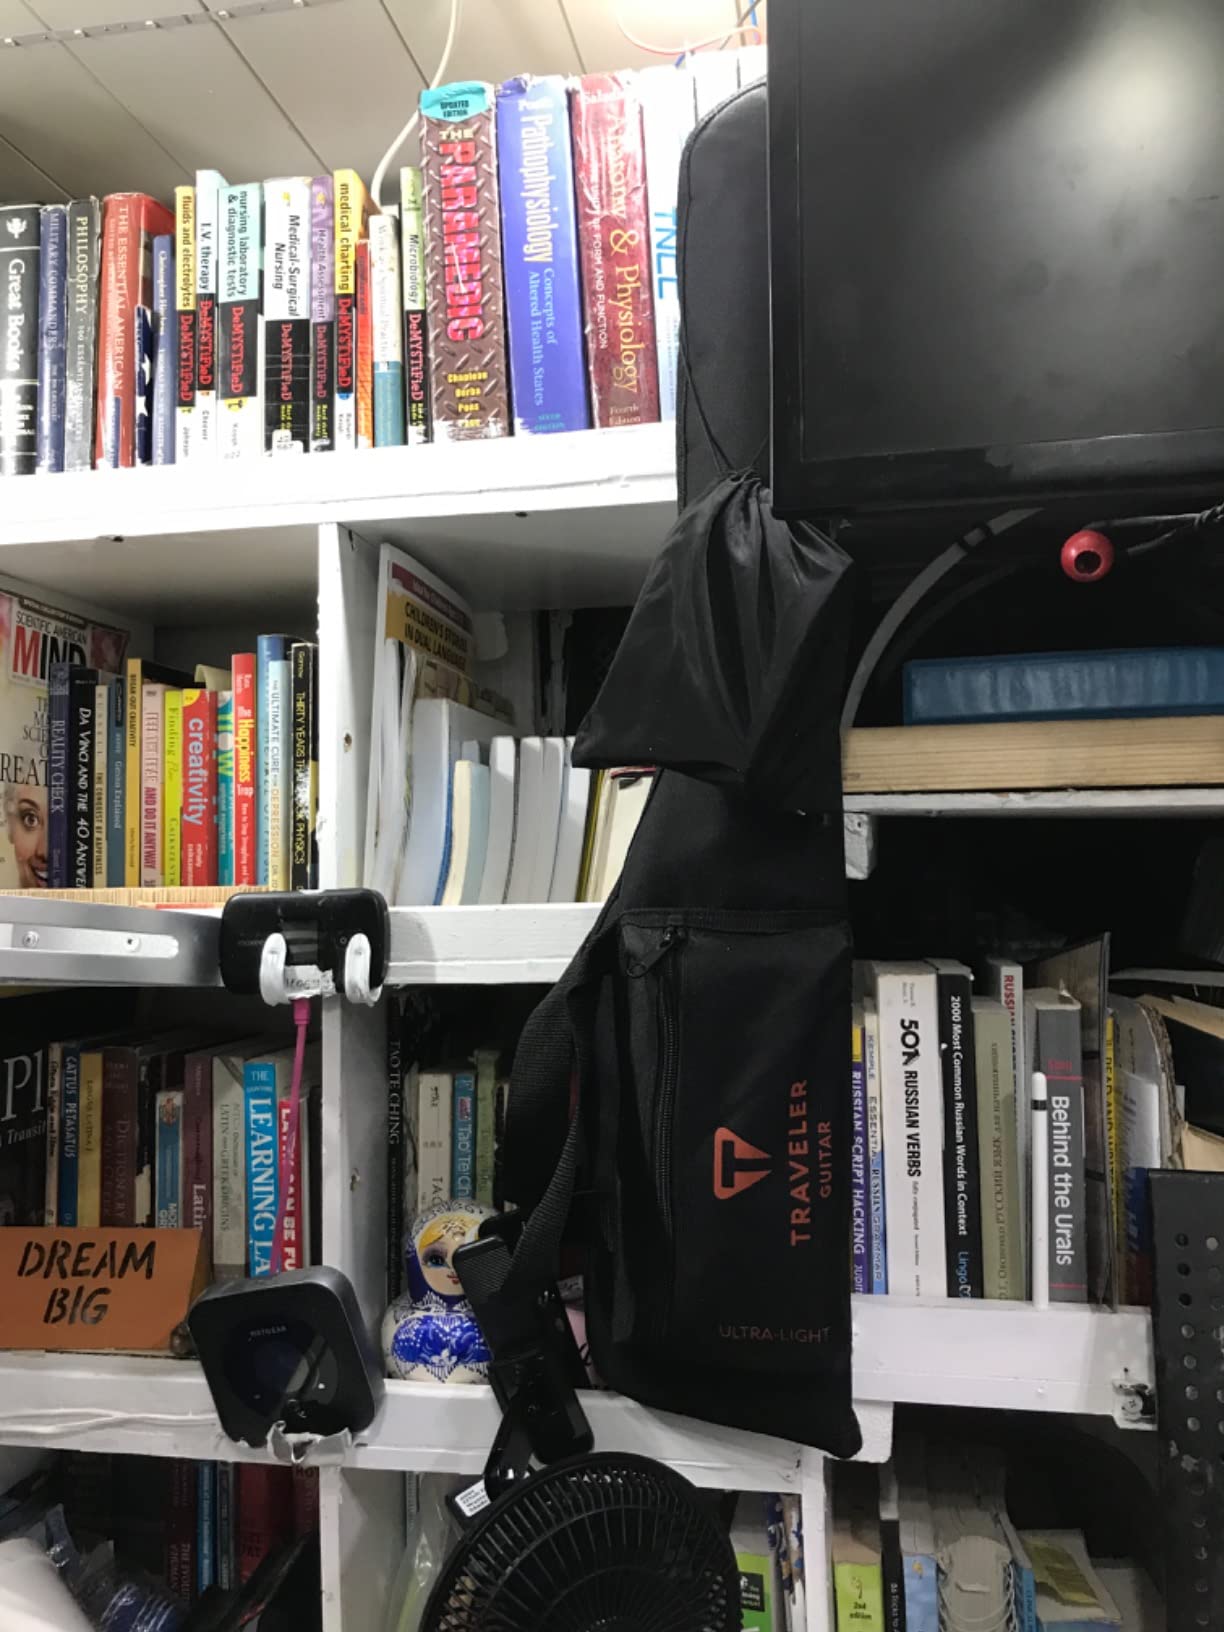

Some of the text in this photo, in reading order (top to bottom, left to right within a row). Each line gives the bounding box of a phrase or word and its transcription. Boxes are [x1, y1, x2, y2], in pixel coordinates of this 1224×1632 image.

[439, 128, 474, 142] THE
[518, 115, 559, 263] Pathophysiology
[75, 216, 88, 314] PHILOSOPHY
[181, 195, 193, 308] fluids and electrolytes
[198, 222, 212, 291] I.V. therapy
[225, 194, 238, 298] & diagnostic tests
[236, 190, 250, 296] nursing laboratory
[272, 242, 286, 290] Nursing
[286, 214, 301, 317] Medical-Surgical
[338, 183, 352, 291] medical charting
[438, 140, 484, 342] PARAMEDIC
[593, 234, 603, 265] FORM
[609, 229, 639, 254] &
[46, 213, 59, 350] MILITARY COMMANDERS
[113, 207, 128, 390] THE ESSENTIAL AMERICAN
[317, 228, 328, 319] Health Assessment
[408, 234, 420, 305] Microbiology
[594, 267, 606, 292] AND
[5, 259, 25, 371] Great Books
[541, 268, 558, 345] Concepts of
[596, 293, 608, 349] FUNCTION
[611, 264, 645, 393] Physiology
[527, 271, 545, 406] Altered Health States
[76, 344, 85, 394] ESSENTIAL
[12, 624, 87, 681] MIND
[16, 610, 51, 634] SCIENTIFIC
[53, 624, 87, 644] AMERICAN
[405, 623, 432, 653] IN DUAL
[297, 651, 305, 679] Gamow
[128, 711, 137, 748] CREATIVITY
[166, 707, 179, 756] Finding
[235, 718, 255, 783] Happiness
[50, 720, 66, 814] REALITY CHECK
[77, 707, 91, 838] DA VINCI AND THE 40
[95, 772, 104, 783] THE
[144, 786, 159, 806] AND
[178, 717, 208, 825] creativity
[270, 692, 281, 858] ULTIMATE CURE DEPRESSION
[294, 692, 306, 865] THIRTY YEARS PHYSICS
[95, 787, 104, 825] CONQUEST
[113, 789, 124, 829] Explained
[144, 807, 159, 820] DO
[144, 821, 159, 831] IT
[95, 836, 104, 876] HAPPINESS
[144, 831, 159, 870] ANYWAY
[388, 1040, 401, 1068] TAO
[388, 1071, 401, 1089] TE
[990, 1041, 1002, 1112] начинающих
[64, 1056, 77, 1158] CATTUS PETASATUS
[388, 1092, 402, 1145] CHING
[903, 1069, 919, 1129] RUSSIAN
[949, 995, 969, 1236] 2000 Most Common Russian Words in Context
[115, 1119, 131, 1218] DICTIONARY
[219, 1103, 229, 1232] LATIN GREEK ORIGINS
[248, 1096, 276, 1231] LEARNING
[457, 1125, 472, 1173] Tao Te
[787, 1079, 811, 1247] TRAVELER
[816, 1121, 833, 1198] GUITAR
[851, 1070, 867, 1254] RUSSIAN SCRIPT HACKING
[867, 1034, 884, 1280] KEMPLE ESSENTIAL RUSSIAN GRAMMAR
[905, 1132, 922, 1178] VERBS
[991, 1135, 1004, 1168] ЯЗЫК
[992, 1169, 1006, 1224] РУССКИЙ
[1050, 1095, 1075, 1266] Behind the Urals
[282, 1216, 297, 1241] BE
[911, 1196, 921, 1231] conjugated
[16, 1239, 157, 1280] DREAM
[42, 1284, 112, 1325] BIG
[719, 1324, 831, 1344] ULTRA-LIGHT
[849, 1611, 872, 1620] edition
[854, 1601, 866, 1610] 2nd
